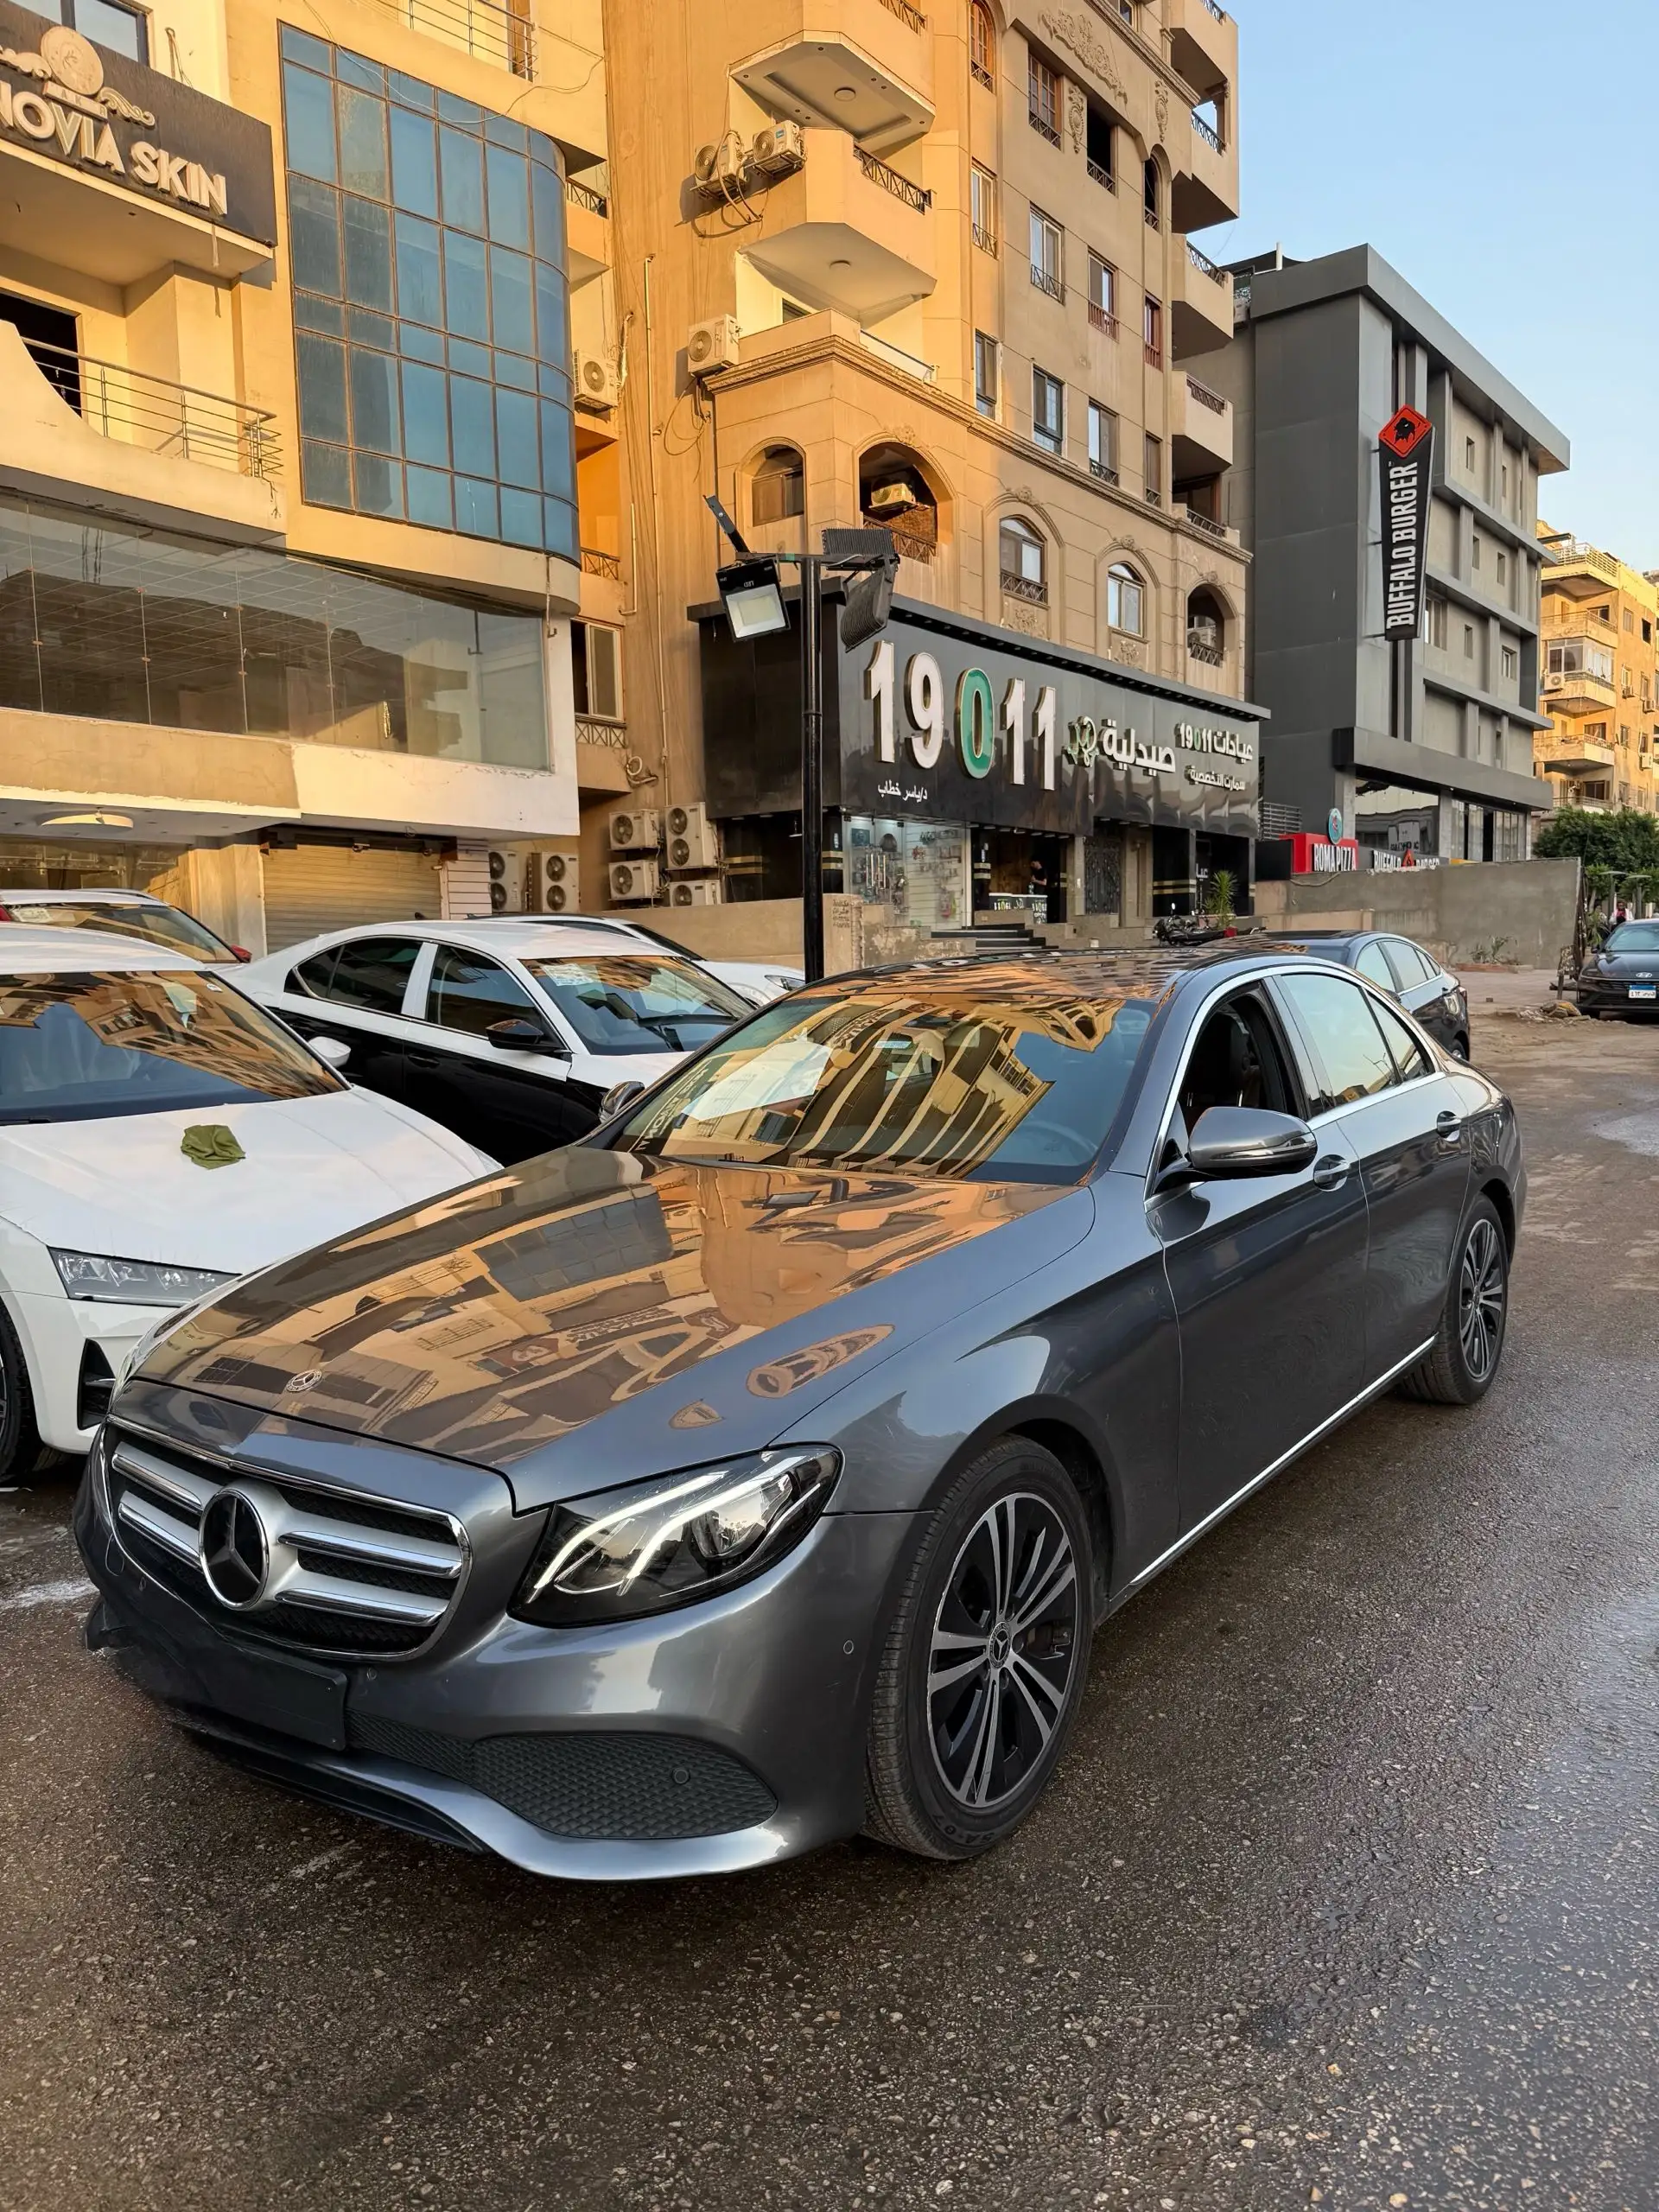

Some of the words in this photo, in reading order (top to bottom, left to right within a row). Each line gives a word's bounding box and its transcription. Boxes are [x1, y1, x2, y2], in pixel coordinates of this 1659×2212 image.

[130, 141, 227, 215] SKIN
[1389, 461, 1418, 543] BURGER
[1386, 545, 1416, 629] BUFFALO
[864, 640, 1056, 791] 19011
[1175, 722, 1212, 753] 19011
[1102, 719, 1176, 776] صيدلية
[1213, 730, 1253, 763] عيادات
[878, 779, 901, 798] خطاب
[1224, 774, 1246, 791] سمارت
[1313, 842, 1336, 873] ROMA
[1336, 846, 1357, 872] PIZZA
